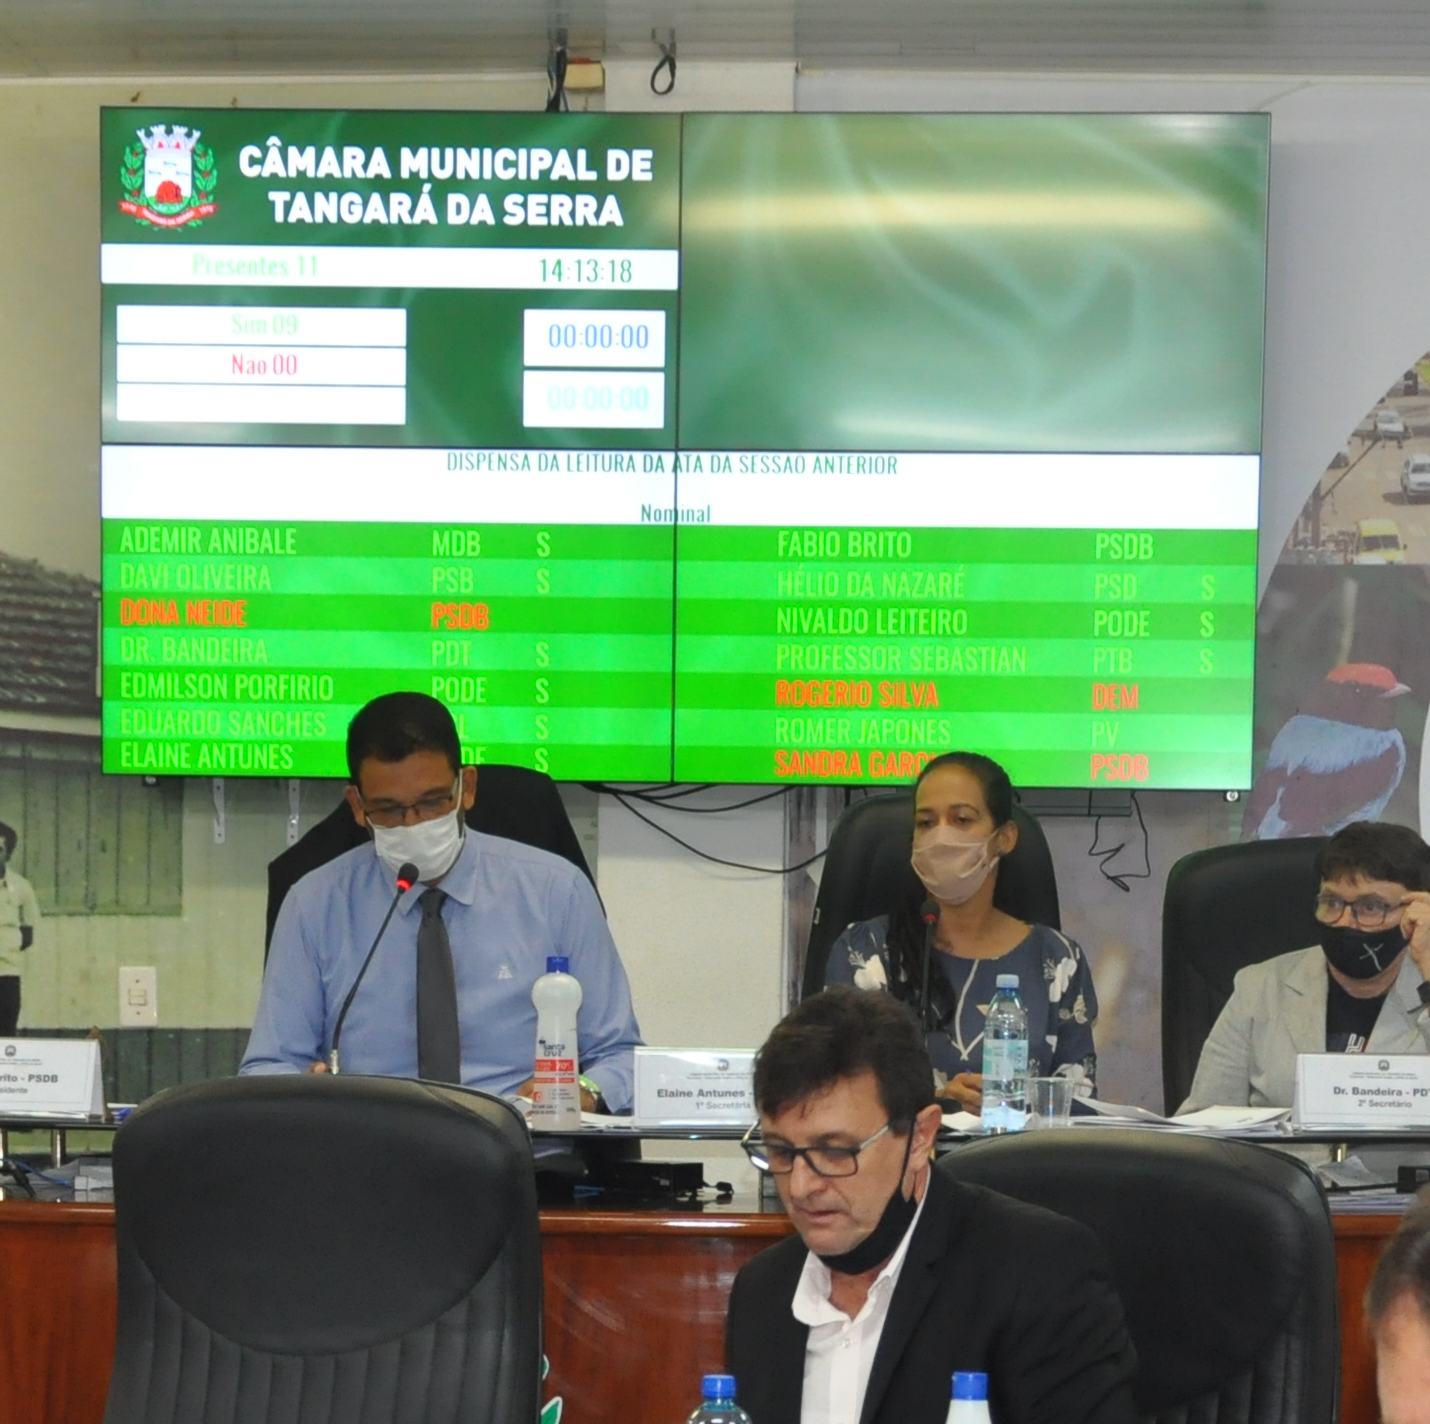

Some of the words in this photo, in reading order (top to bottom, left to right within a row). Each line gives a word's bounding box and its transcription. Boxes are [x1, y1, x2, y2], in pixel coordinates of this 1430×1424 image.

[239, 137, 392, 180] CÂMARA
[400, 146, 596, 181] MUNICIPAL
[607, 149, 653, 182] DE
[268, 183, 438, 225] TANGARÁ
[447, 193, 495, 226] DA
[503, 194, 624, 227] SERRA
[192, 252, 289, 276] Presentes
[298, 254, 318, 277] 11
[538, 258, 633, 283] 14:13:18
[231, 312, 268, 335] Sim
[272, 313, 300, 336] 09
[548, 323, 650, 349] 00:00:00
[272, 353, 299, 377] 00
[547, 385, 650, 412] 00:00:00
[447, 451, 531, 472] DISPENSA
[538, 452, 561, 473] DA
[566, 452, 637, 473] LEITURA
[642, 453, 666, 474] DA
[672, 453, 704, 474] ATA
[710, 454, 733, 474] DA
[812, 455, 898, 475] ANTERIOR
[641, 503, 711, 523] Nominal
[120, 526, 202, 555] ADEMIR
[208, 527, 298, 556] ANIBALE
[432, 530, 482, 558] MDB
[536, 532, 551, 559] S
[777, 530, 841, 558] FABIO
[847, 531, 913, 559] BRITO
[1095, 533, 1154, 560] PSDB
[120, 562, 170, 590] DAVI
[175, 564, 272, 592] OLIVEIRA
[432, 566, 475, 593] PSB
[536, 568, 551, 595] S
[776, 563, 841, 598] HÉLIO
[846, 571, 876, 598] DA
[881, 564, 966, 599] NAZARÉ
[1094, 573, 1138, 600] PSD
[1200, 574, 1216, 600] S
[120, 598, 180, 626] DONA
[186, 600, 247, 628] NEIDE
[431, 602, 490, 630] PSDB
[776, 607, 870, 635] NIVALDO
[876, 608, 969, 636] LEITEIRO
[1093, 610, 1151, 637] PODE
[1200, 611, 1215, 638] S
[120, 636, 157, 662] DR.
[162, 636, 269, 664] BANDEIRA
[431, 640, 472, 667] PDT
[535, 641, 551, 668] S
[776, 645, 901, 672] PROFESSOR
[909, 646, 1027, 674] SEBASTIAN
[1093, 647, 1134, 674] PTB
[1199, 649, 1214, 675] S
[120, 672, 229, 699] EDMILSON
[235, 674, 335, 701] PORFIRIO
[432, 676, 487, 703] PODE
[535, 677, 550, 704] S
[775, 680, 872, 708] ROGERIO
[878, 681, 940, 709] SILVA
[1092, 683, 1140, 710] DEM
[120, 709, 221, 736] EDUARDO
[227, 710, 327, 738] SANCHES
[535, 713, 550, 741] S
[775, 717, 851, 744] ROMER
[857, 718, 952, 746] JAPONES
[1091, 720, 1119, 746] PV
[120, 741, 191, 768] ELAINE
[198, 742, 294, 770] ANTUNES
[461, 745, 487, 765] DE
[534, 747, 550, 773] S
[775, 750, 863, 778] SANDRA
[868, 751, 937, 778] GARC
[1091, 753, 1150, 781] PSDB
[27, 1074, 59, 1084] PSDB
[657, 1088, 693, 1099] Elaine
[696, 1088, 746, 1099] Antunes
[1333, 1086, 1349, 1096] Dr.
[1352, 1086, 1403, 1097] Bandeira
[1368, 1099, 1413, 1109] Secretário
